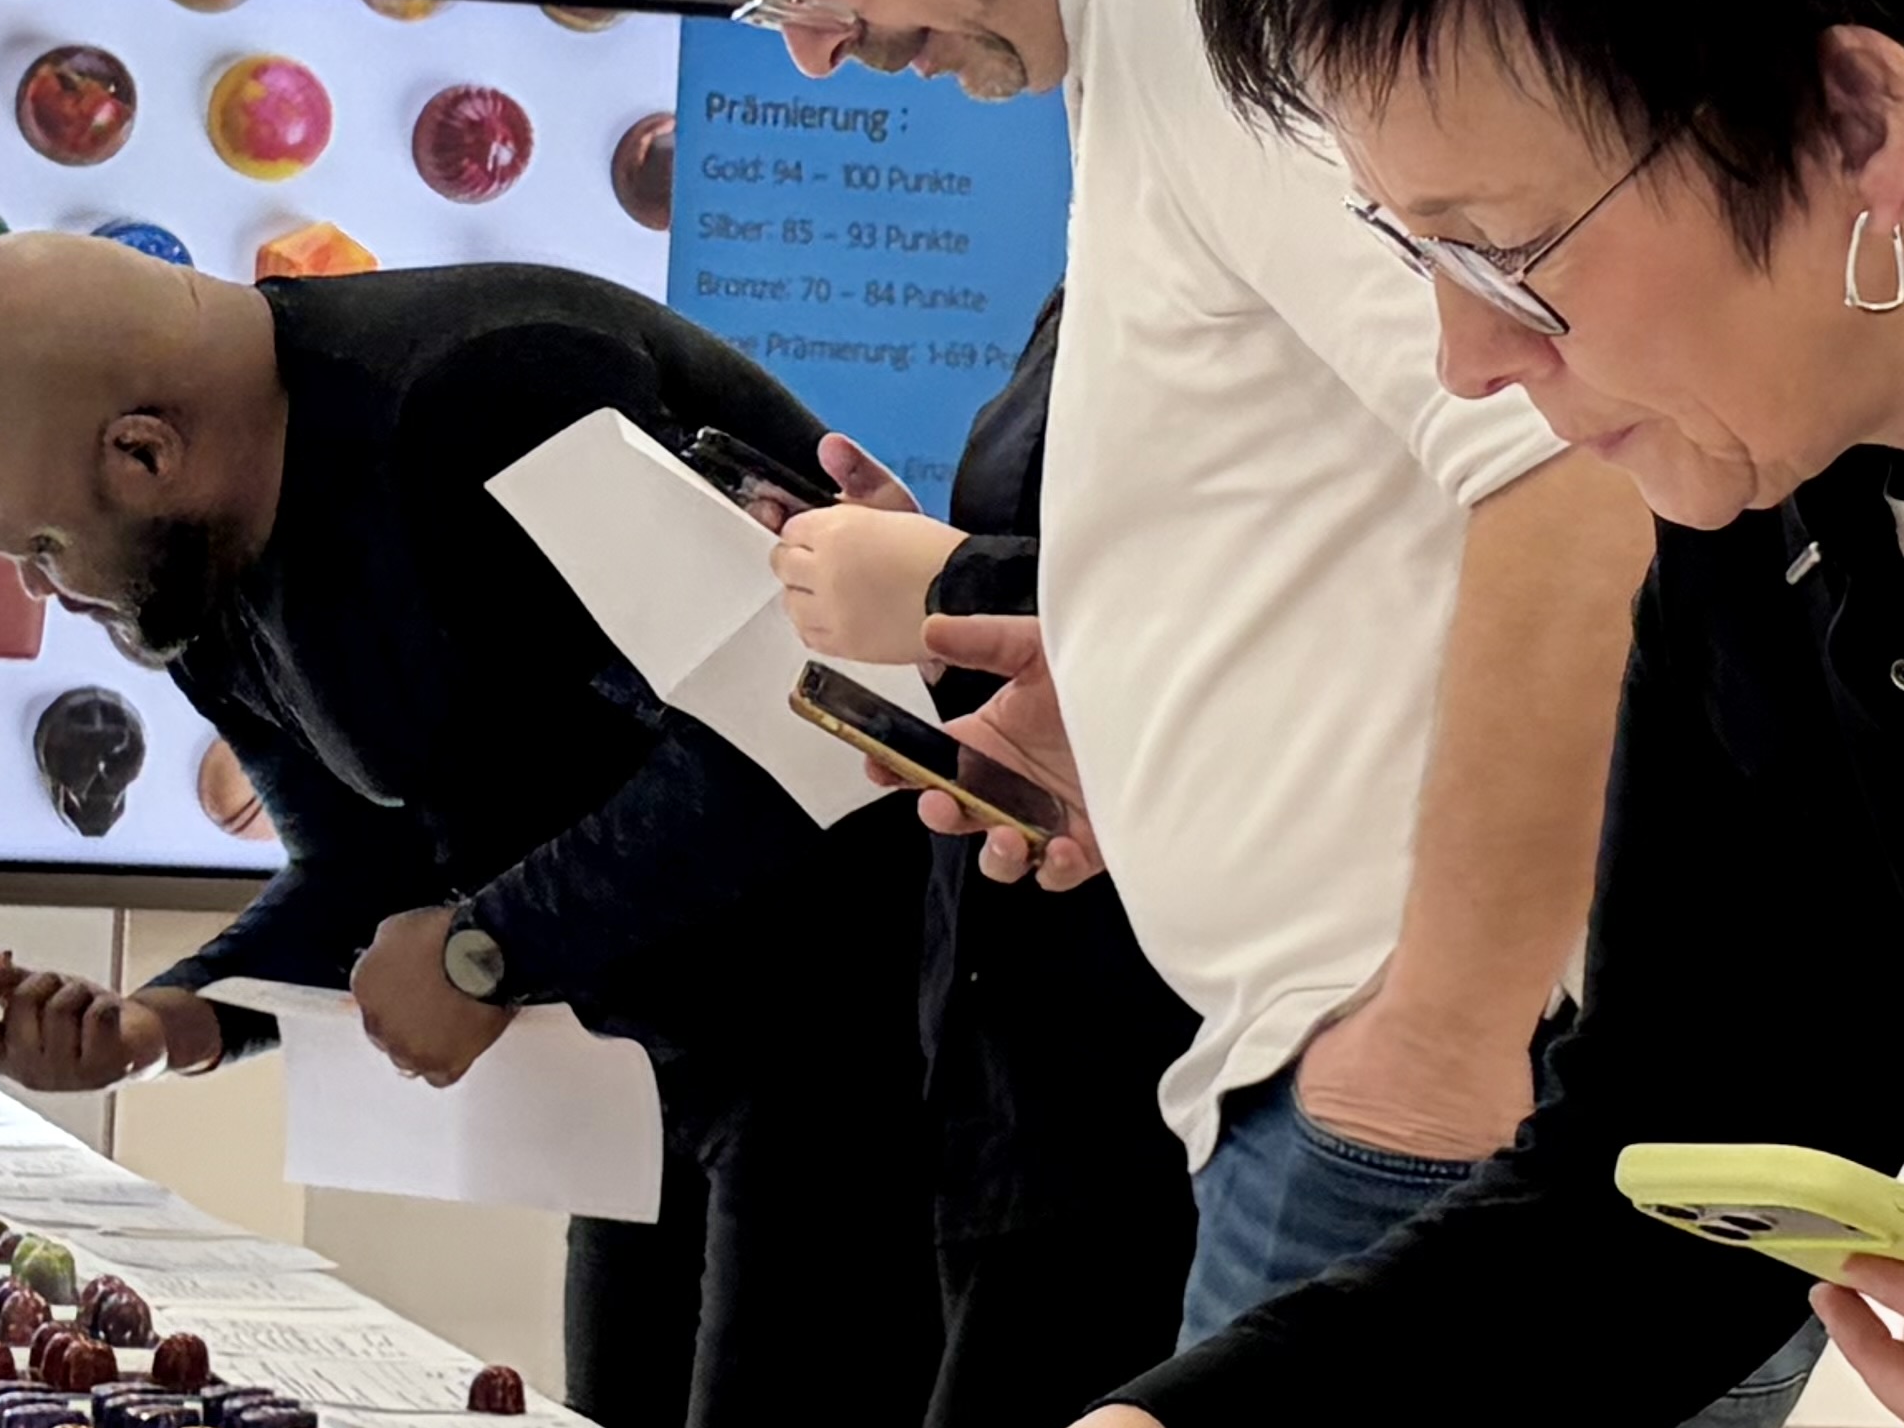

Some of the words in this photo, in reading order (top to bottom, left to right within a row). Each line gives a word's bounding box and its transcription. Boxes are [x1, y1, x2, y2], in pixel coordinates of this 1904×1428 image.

[704, 91, 890, 143] Prämierung
[772, 160, 803, 186] 94
[842, 163, 881, 190] 100
[888, 167, 973, 197] Punkte
[781, 218, 814, 246] 85
[847, 226, 877, 250] 93
[884, 227, 971, 255] Punkte
[801, 276, 832, 303] 70
[863, 281, 896, 307] 84
[903, 284, 990, 313] Punkte
